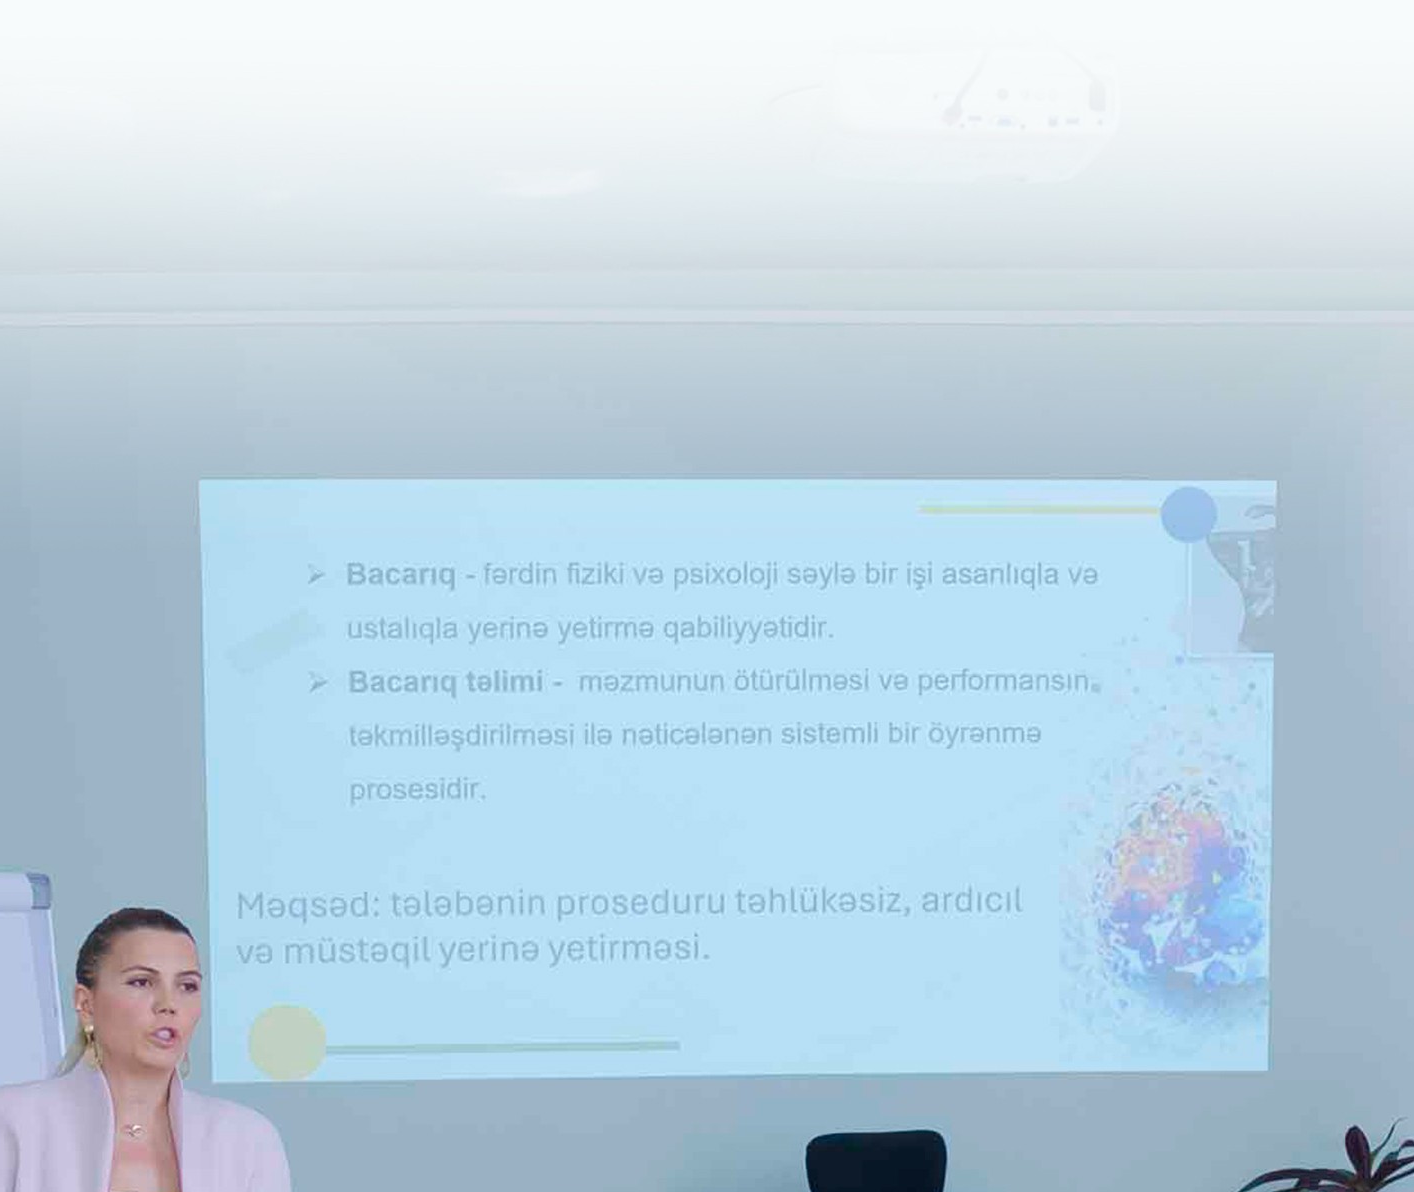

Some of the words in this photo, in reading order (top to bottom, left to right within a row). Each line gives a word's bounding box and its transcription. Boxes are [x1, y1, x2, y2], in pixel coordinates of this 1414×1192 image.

[347, 562, 455, 591] Bacarıq
[484, 561, 557, 586] fərdin
[567, 562, 624, 585] fiziki
[632, 567, 663, 585] və
[674, 561, 777, 591] psixoloji
[787, 561, 856, 590] səylə
[865, 561, 898, 587] bir
[907, 561, 932, 590] işi
[943, 562, 1059, 591] asanlıqla
[1068, 567, 1098, 585] və
[348, 616, 458, 645] ustalıqla
[468, 616, 548, 645] yerinə
[558, 616, 654, 645] yetirmə
[349, 670, 456, 699] Bacarıq
[465, 669, 542, 692] təlimi
[579, 672, 724, 692] məzmunun
[735, 668, 869, 692] ötürülməsi
[878, 673, 908, 690] və
[349, 723, 574, 752] təkmilləşdirilməsi
[585, 722, 612, 745] ilə
[622, 722, 772, 746] nəticələnən
[782, 722, 878, 744] sistemli
[889, 722, 921, 744] bir
[928, 722, 1041, 749] öyrənmə
[351, 777, 486, 806] prosesidir.
[238, 892, 379, 924] Məqsəd:
[392, 888, 545, 918] tələbənin
[558, 889, 724, 922] proseduru
[735, 886, 910, 917] təhlükəsiz,
[922, 885, 1023, 913] ardıcıl
[236, 944, 272, 964] və
[285, 936, 430, 968] müstəqil
[438, 935, 539, 968] yerinə
[548, 933, 709, 968] yetirməsi.
